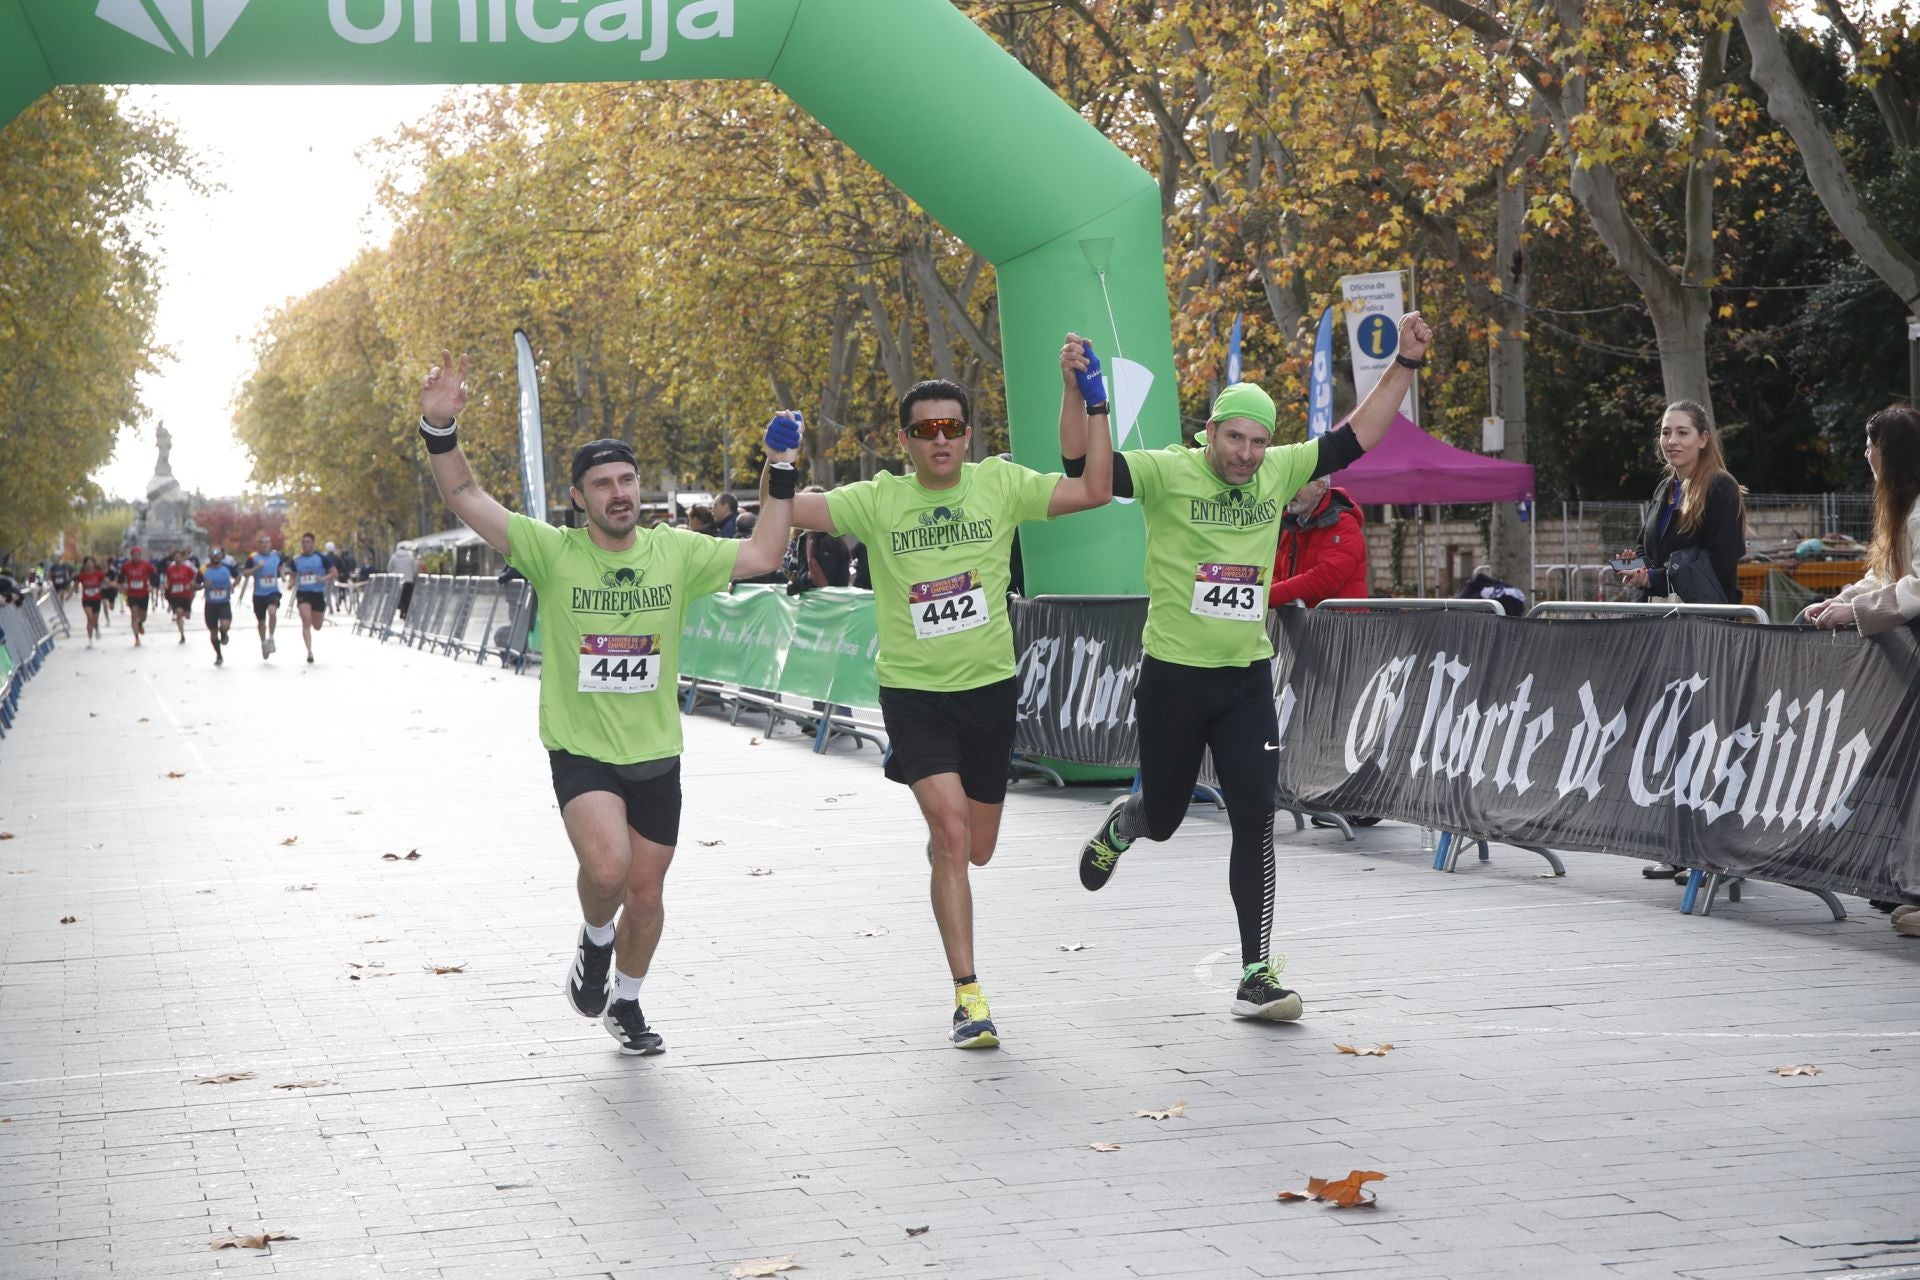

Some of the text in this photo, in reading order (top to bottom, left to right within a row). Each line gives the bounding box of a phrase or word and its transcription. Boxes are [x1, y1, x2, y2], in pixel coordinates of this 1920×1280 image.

[1190, 498, 1277, 526] ENTREPINARES
[890, 518, 993, 552] ENTREPINARES
[571, 584, 673, 611] ENTREPINARES
[922, 594, 977, 625] 442
[1203, 585, 1255, 610] 443
[590, 658, 648, 682] 444
[1060, 635, 1146, 732] Nor
[1345, 654, 1417, 774] El
[1410, 651, 1555, 797] Norte
[1555, 680, 1628, 803] de
[1628, 671, 1873, 835] Castilla
